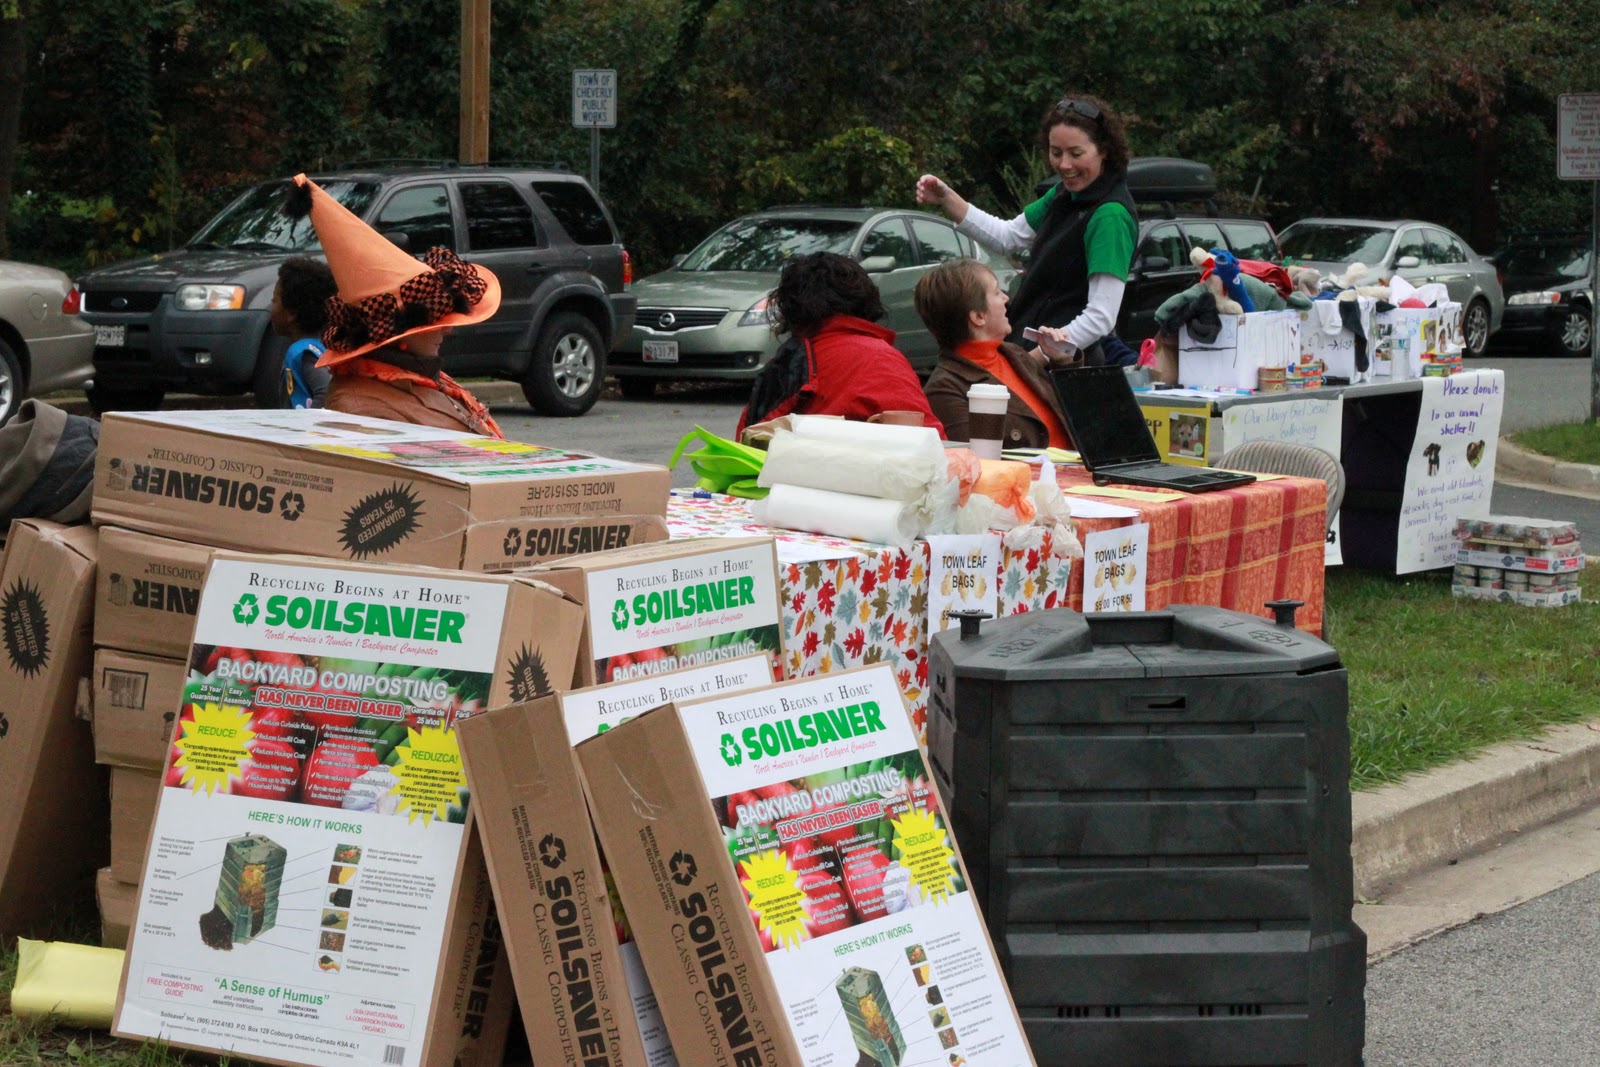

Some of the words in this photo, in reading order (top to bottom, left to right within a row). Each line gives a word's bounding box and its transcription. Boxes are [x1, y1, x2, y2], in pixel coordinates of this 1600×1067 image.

[579, 75, 598, 85] TOWN
[602, 76, 610, 85] OF
[576, 88, 612, 98] CHEVERLY
[582, 100, 607, 110] PUBLIC
[582, 112, 607, 122] WORKS
[1443, 379, 1469, 396] Please
[1473, 375, 1499, 395] donate
[220, 460, 263, 479] CLASSIC
[131, 463, 276, 514] SOILSAVER
[582, 482, 615, 496] MODEL
[359, 506, 382, 526] YEARS
[382, 499, 395, 511] 25
[357, 507, 406, 544] GUARANTEED
[524, 524, 631, 557] SOILSAVER
[942, 555, 965, 569] TOWN
[967, 556, 987, 568] LEAF
[1094, 548, 1116, 564] TOWN
[1119, 544, 1137, 559] LEAF
[617, 574, 667, 592] RECYCLING
[672, 568, 704, 582] BEGINS
[709, 566, 718, 576] AT
[952, 575, 975, 588] BAGS
[1105, 564, 1125, 579] BAGS
[249, 573, 325, 593] RECYCLING
[334, 580, 384, 598] BEGINS
[392, 590, 410, 600] AT
[633, 576, 755, 626] SOILSAVER
[1113, 595, 1124, 607] FOR
[11, 612, 19, 622] 25
[266, 595, 466, 644] SOILSAVER
[14, 624, 26, 652] YEARS
[18, 600, 38, 657] GUARANTEED
[264, 630, 287, 640] North
[326, 636, 353, 648] Number
[362, 639, 398, 652] Backyard
[400, 643, 438, 656] Composter
[613, 656, 678, 681] BACKYARD
[679, 640, 755, 668] COMPOSTING
[209, 685, 221, 694] Year
[217, 658, 317, 686] BACKYARD
[320, 670, 450, 700] COMPOSTING
[517, 682, 526, 695] 25
[190, 692, 220, 702] Guarantee
[224, 696, 252, 707] Assembly
[228, 688, 243, 696] Easy
[598, 692, 655, 714] RECYCLING
[660, 686, 695, 701] BEGINS
[700, 682, 710, 692] AT
[258, 689, 283, 704] HAS
[285, 692, 324, 709] NEVER
[326, 696, 358, 712] BEEN
[360, 701, 403, 718] EASIER
[717, 703, 777, 726] RECYCLING
[780, 695, 824, 712] BEGINS
[823, 692, 834, 703] AT
[198, 725, 237, 739] REDUCE!
[741, 700, 886, 760] SOILSAVER
[411, 750, 459, 764] REDUZCA!
[736, 787, 812, 826] BACKYARD
[812, 766, 900, 805] COMPOSTING
[248, 811, 284, 824] HERE'S
[286, 816, 311, 828] HOW
[313, 819, 322, 828] IT
[325, 821, 362, 834] WORKS
[780, 824, 800, 838] HAS
[800, 816, 828, 834] NEVER
[829, 810, 850, 825] BEEN
[852, 801, 882, 818] EASIER
[512, 807, 520, 826] 100%
[516, 827, 529, 861] RECYCLED
[525, 862, 536, 890] PLASTIC
[519, 805, 531, 838] MATERIAL
[527, 839, 537, 861] INSIDE
[532, 862, 545, 896] CONTAINS
[645, 825, 660, 858] MATERIAL
[658, 859, 670, 882] INSIDE
[665, 882, 680, 916] CONTAINS
[756, 874, 786, 890] REDUCE!
[533, 901, 555, 966] CLASSIC
[833, 940, 860, 956] HERE'S
[860, 935, 878, 948] HOW
[878, 932, 885, 942] IT
[886, 923, 913, 939] WORKS
[572, 868, 597, 947] RECYCLING
[591, 950, 608, 1000] BEGINS
[602, 1007, 614, 1024] AT
[671, 923, 699, 986] CLASSIC
[545, 875, 610, 1067] SOILSAVE
[147, 977, 163, 987] FREE
[163, 980, 204, 993] COMPOSTING
[165, 988, 184, 998] GUIDE
[231, 980, 265, 996] Sense
[268, 986, 281, 998] of
[270, 1029, 293, 1039] Cobourg
[294, 1033, 314, 1042] Ontario
[316, 1037, 336, 1045] Canada
